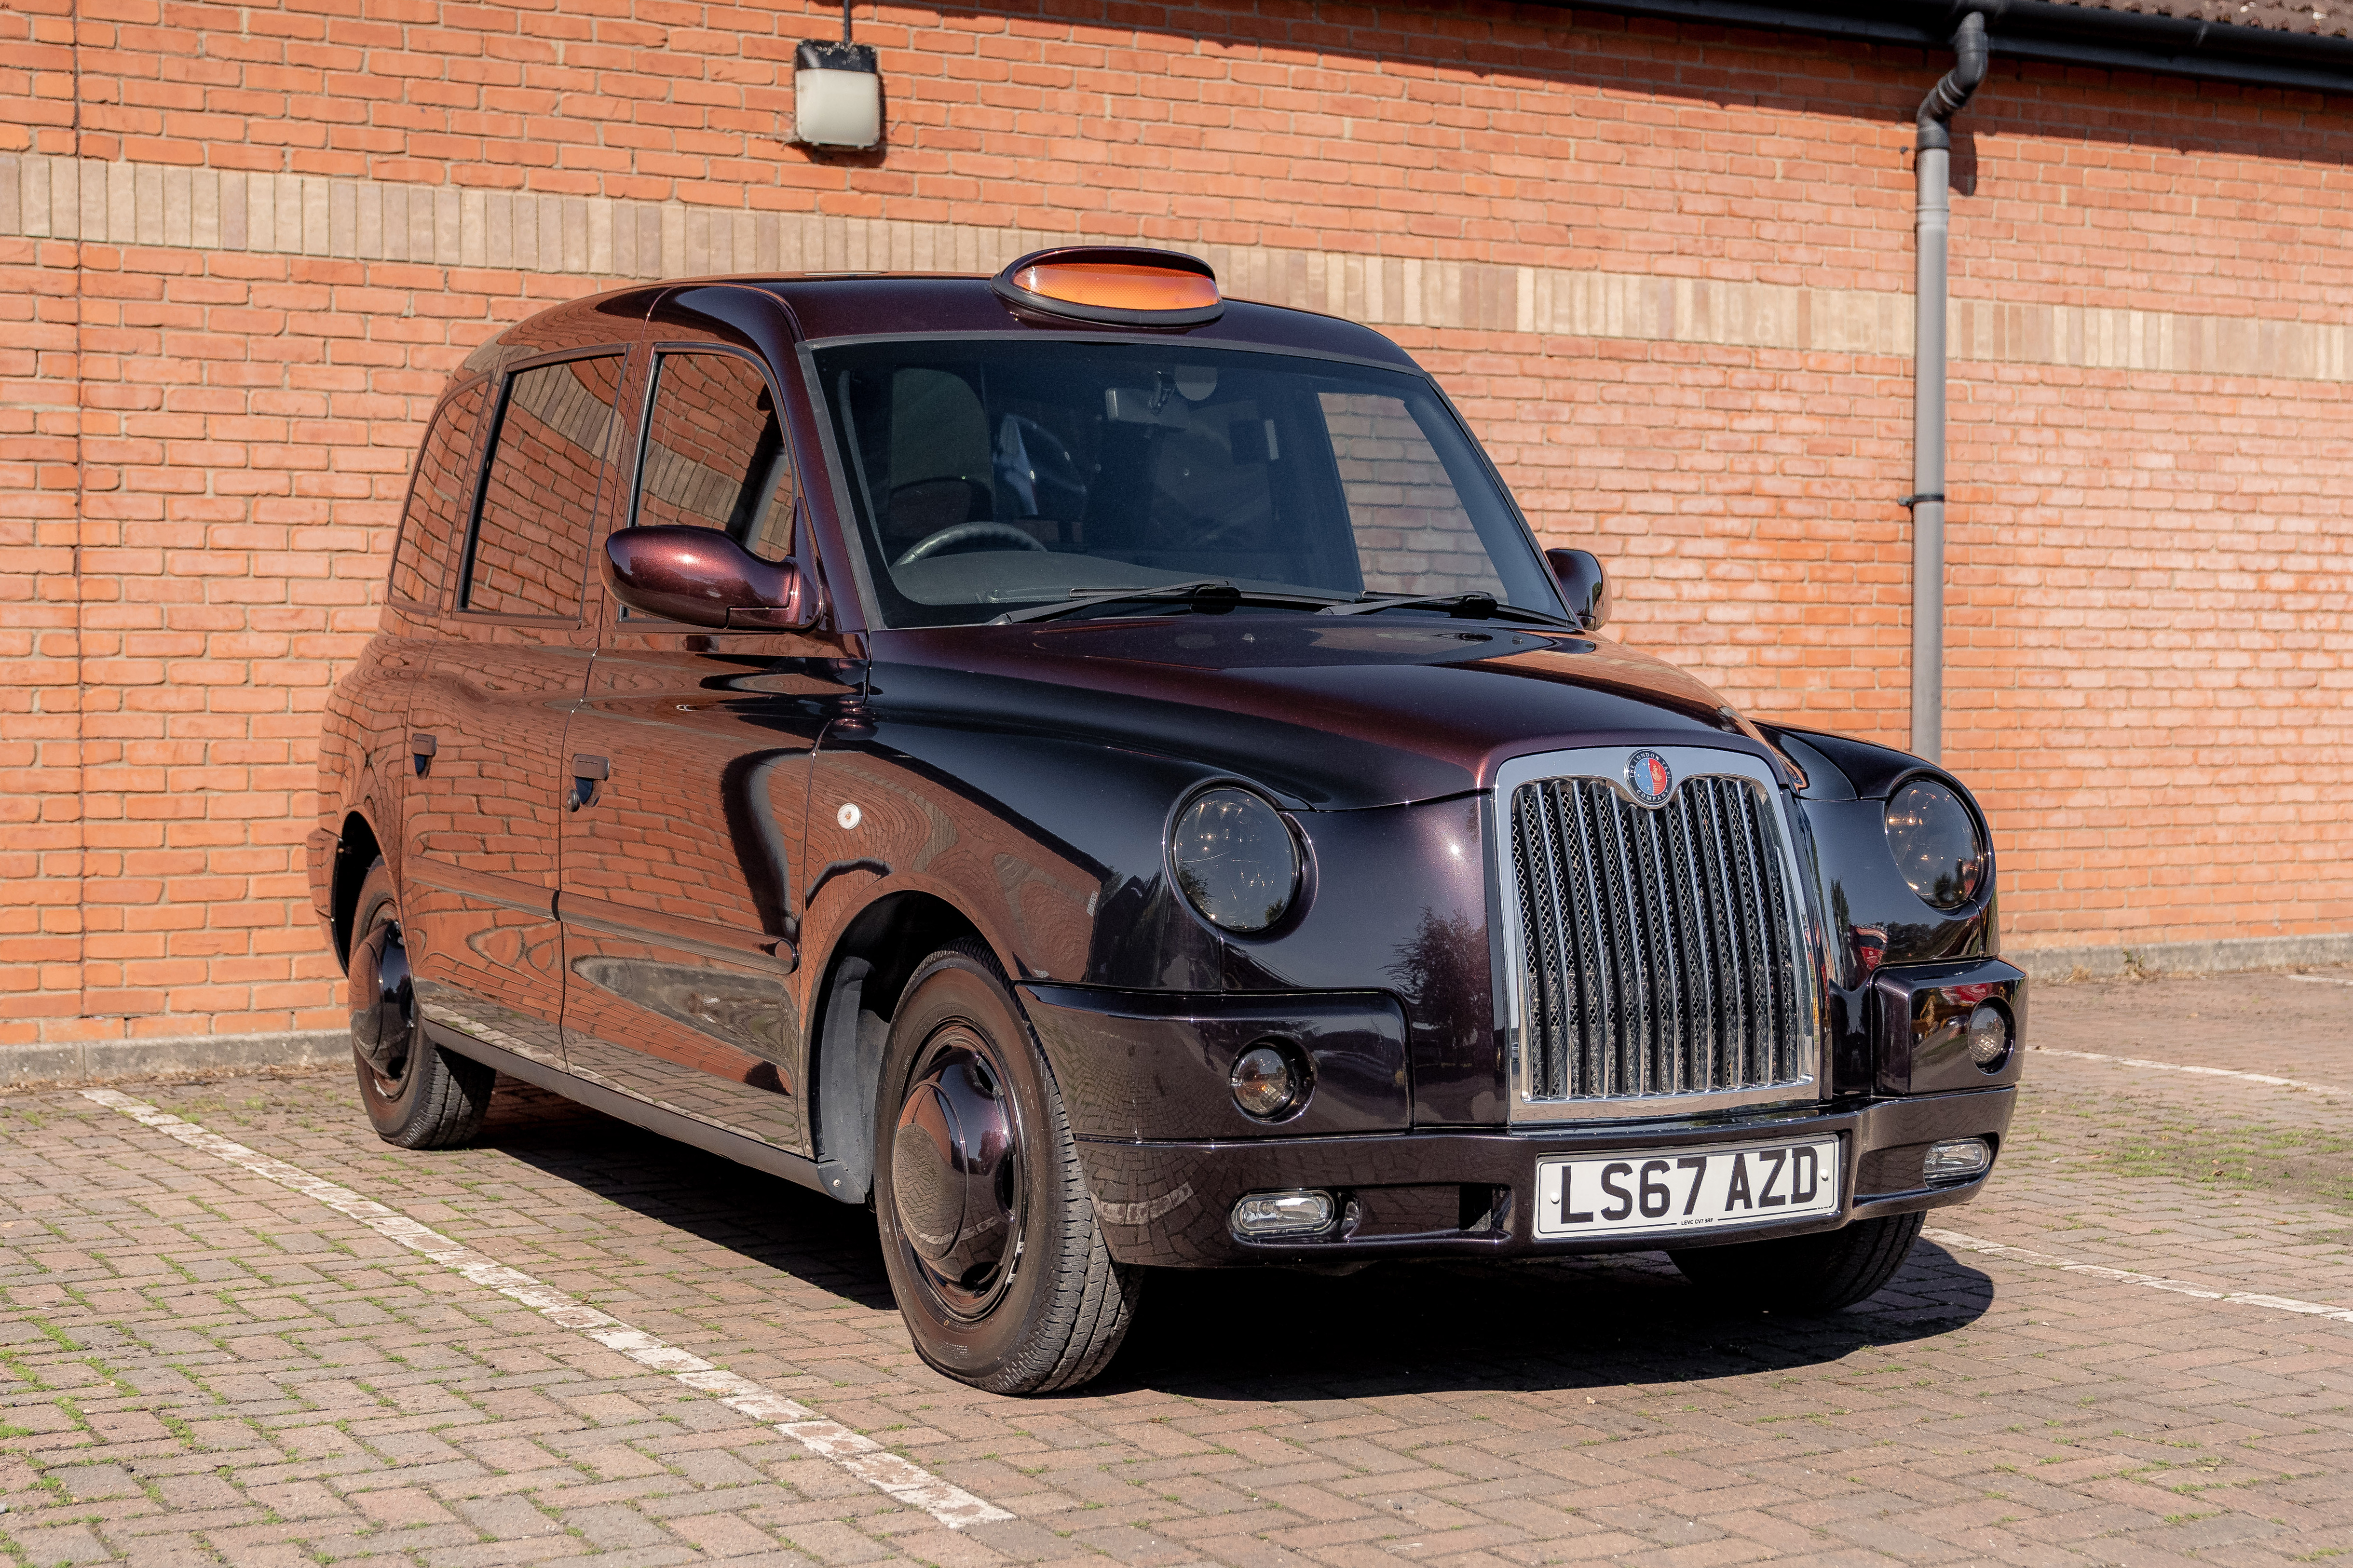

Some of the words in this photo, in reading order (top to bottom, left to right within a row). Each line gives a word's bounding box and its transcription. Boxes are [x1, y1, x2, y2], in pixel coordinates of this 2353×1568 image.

[1633, 752, 1659, 763] LONDON
[1661, 761, 1671, 778] TAXI
[1637, 789, 1669, 801] COMPANY
[1561, 1156, 1708, 1224] LS67
[1725, 1146, 1818, 1211] AZD
